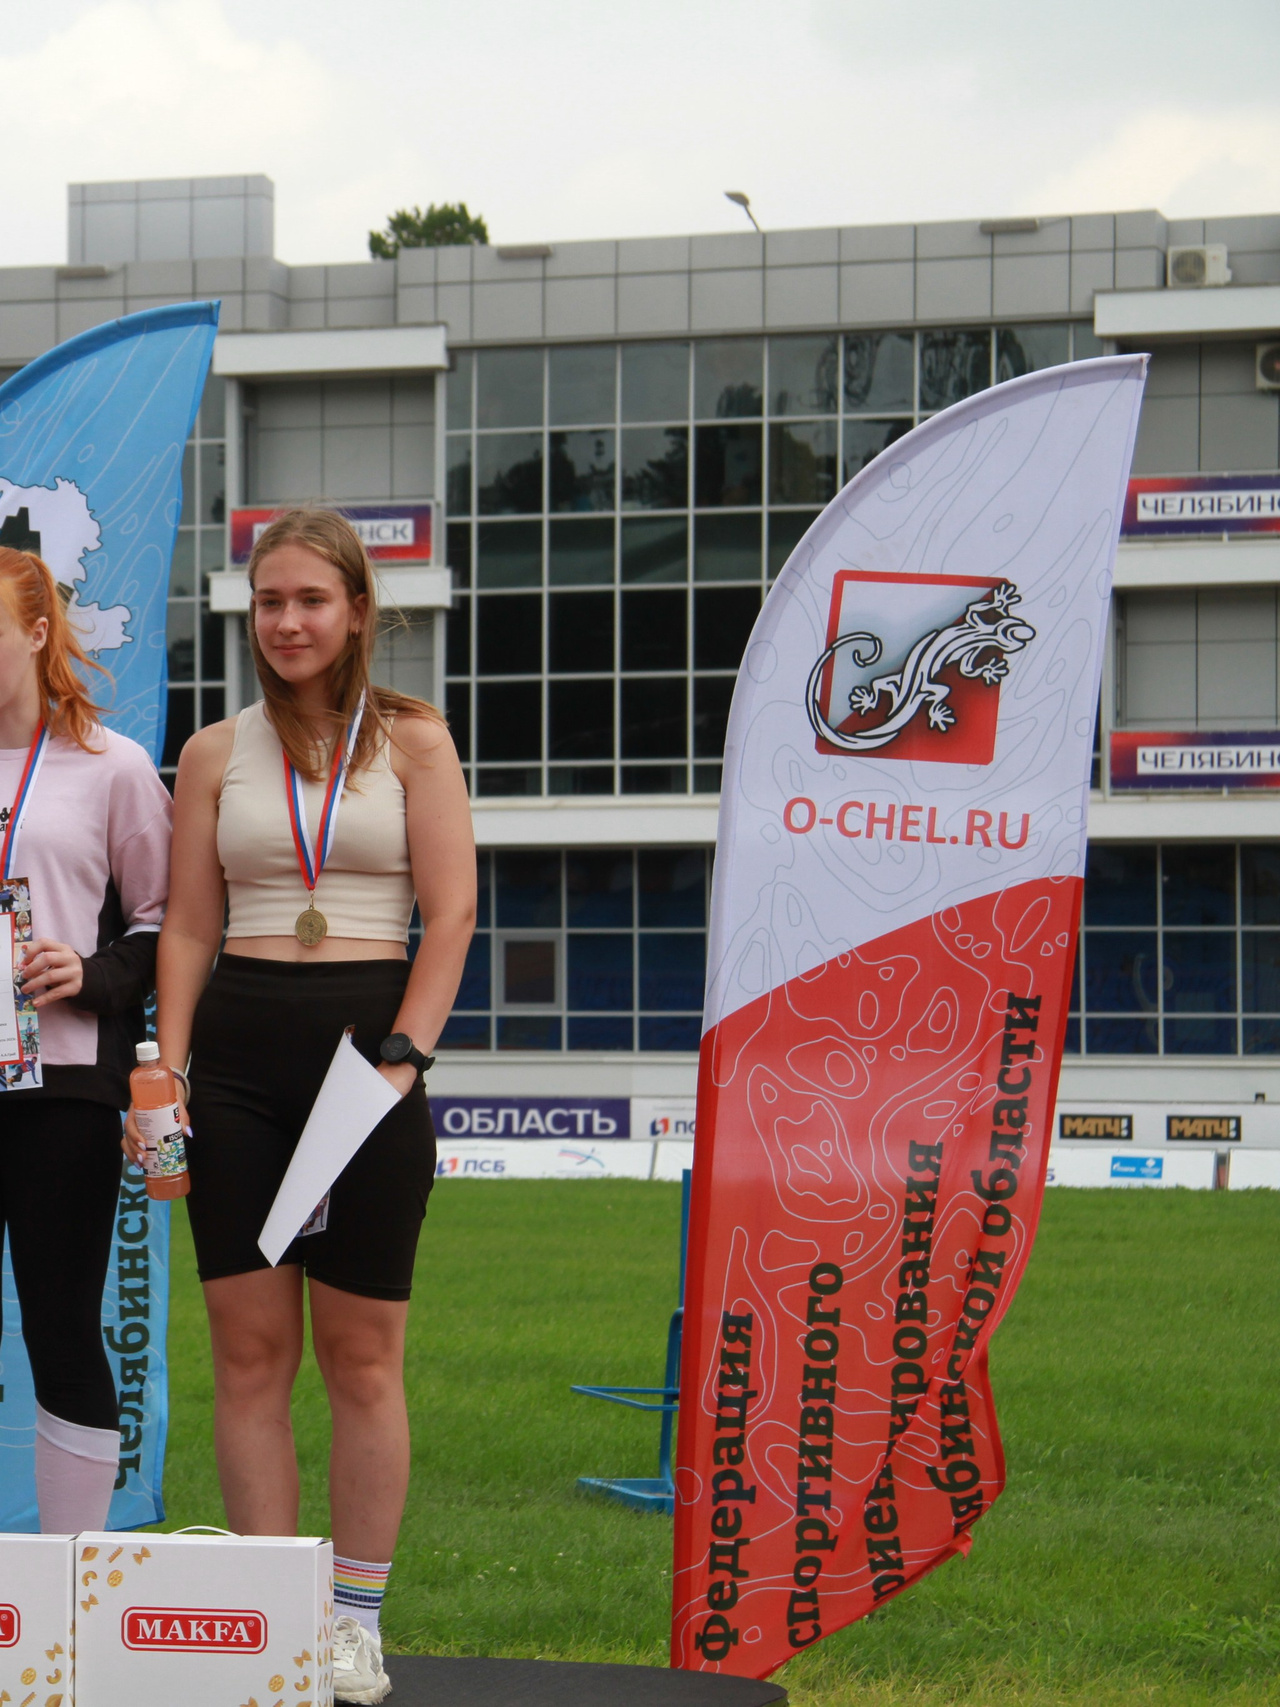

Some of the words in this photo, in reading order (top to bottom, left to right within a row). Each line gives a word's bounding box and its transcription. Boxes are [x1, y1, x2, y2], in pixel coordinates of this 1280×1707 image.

[1140, 494, 1280, 516] ЧЕЛЯБИН
[1140, 750, 1280, 770] ЧЕЛЯБИН
[782, 796, 1030, 850] O-CHEL.RU
[442, 1106, 618, 1135] ОБЛАСТЬ
[786, 1262, 844, 1649] спортивного
[694, 1310, 759, 1662] Федерация
[136, 1618, 252, 1642] MAKFA
